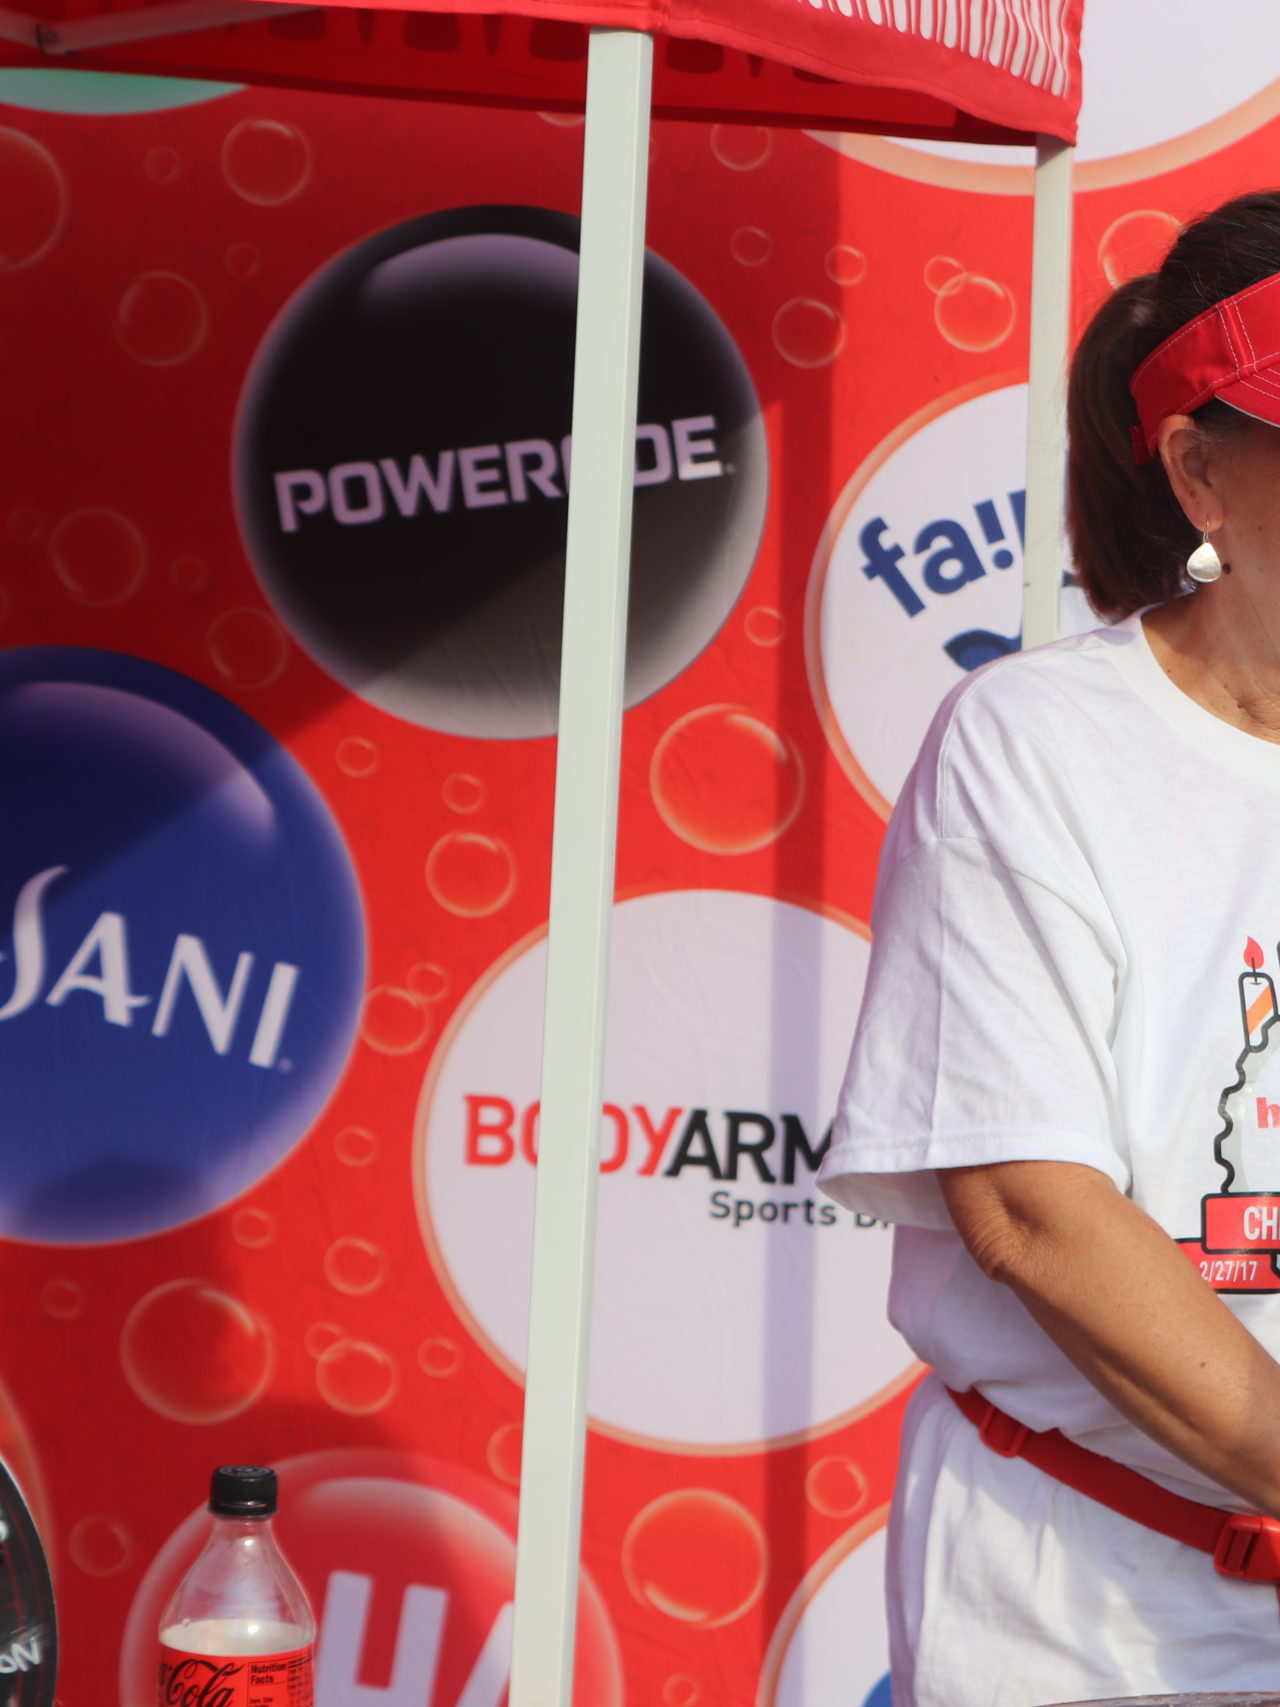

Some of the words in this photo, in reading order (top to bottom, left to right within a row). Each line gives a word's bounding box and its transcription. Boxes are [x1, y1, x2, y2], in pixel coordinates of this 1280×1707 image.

[273, 415, 723, 533] POWERDE
[709, 1191, 838, 1228] Sports
[1199, 1260, 1259, 1282] 2/27/17
[250, 1674, 274, 1685] Facts
[251, 1663, 287, 1674] Nutrition
